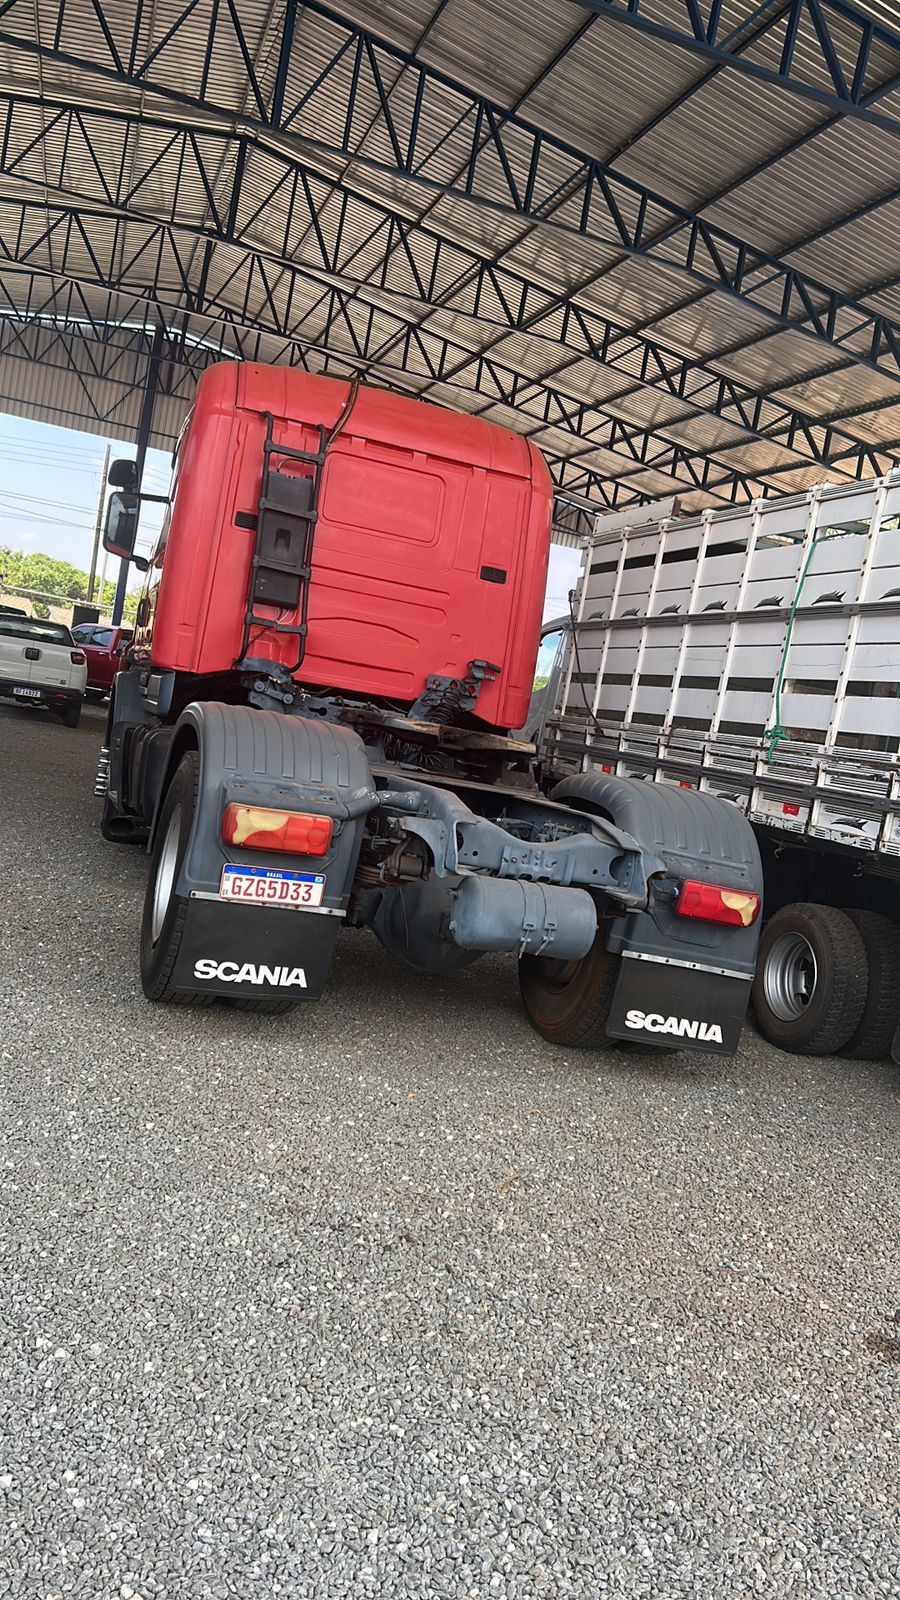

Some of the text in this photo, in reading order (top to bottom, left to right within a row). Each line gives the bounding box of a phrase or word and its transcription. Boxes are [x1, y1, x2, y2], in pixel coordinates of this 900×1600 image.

[266, 871, 283, 879] BRASIL
[231, 877, 313, 902] GZG5D33
[193, 960, 308, 988] SCANIA
[625, 1010, 723, 1044] SCANIA
